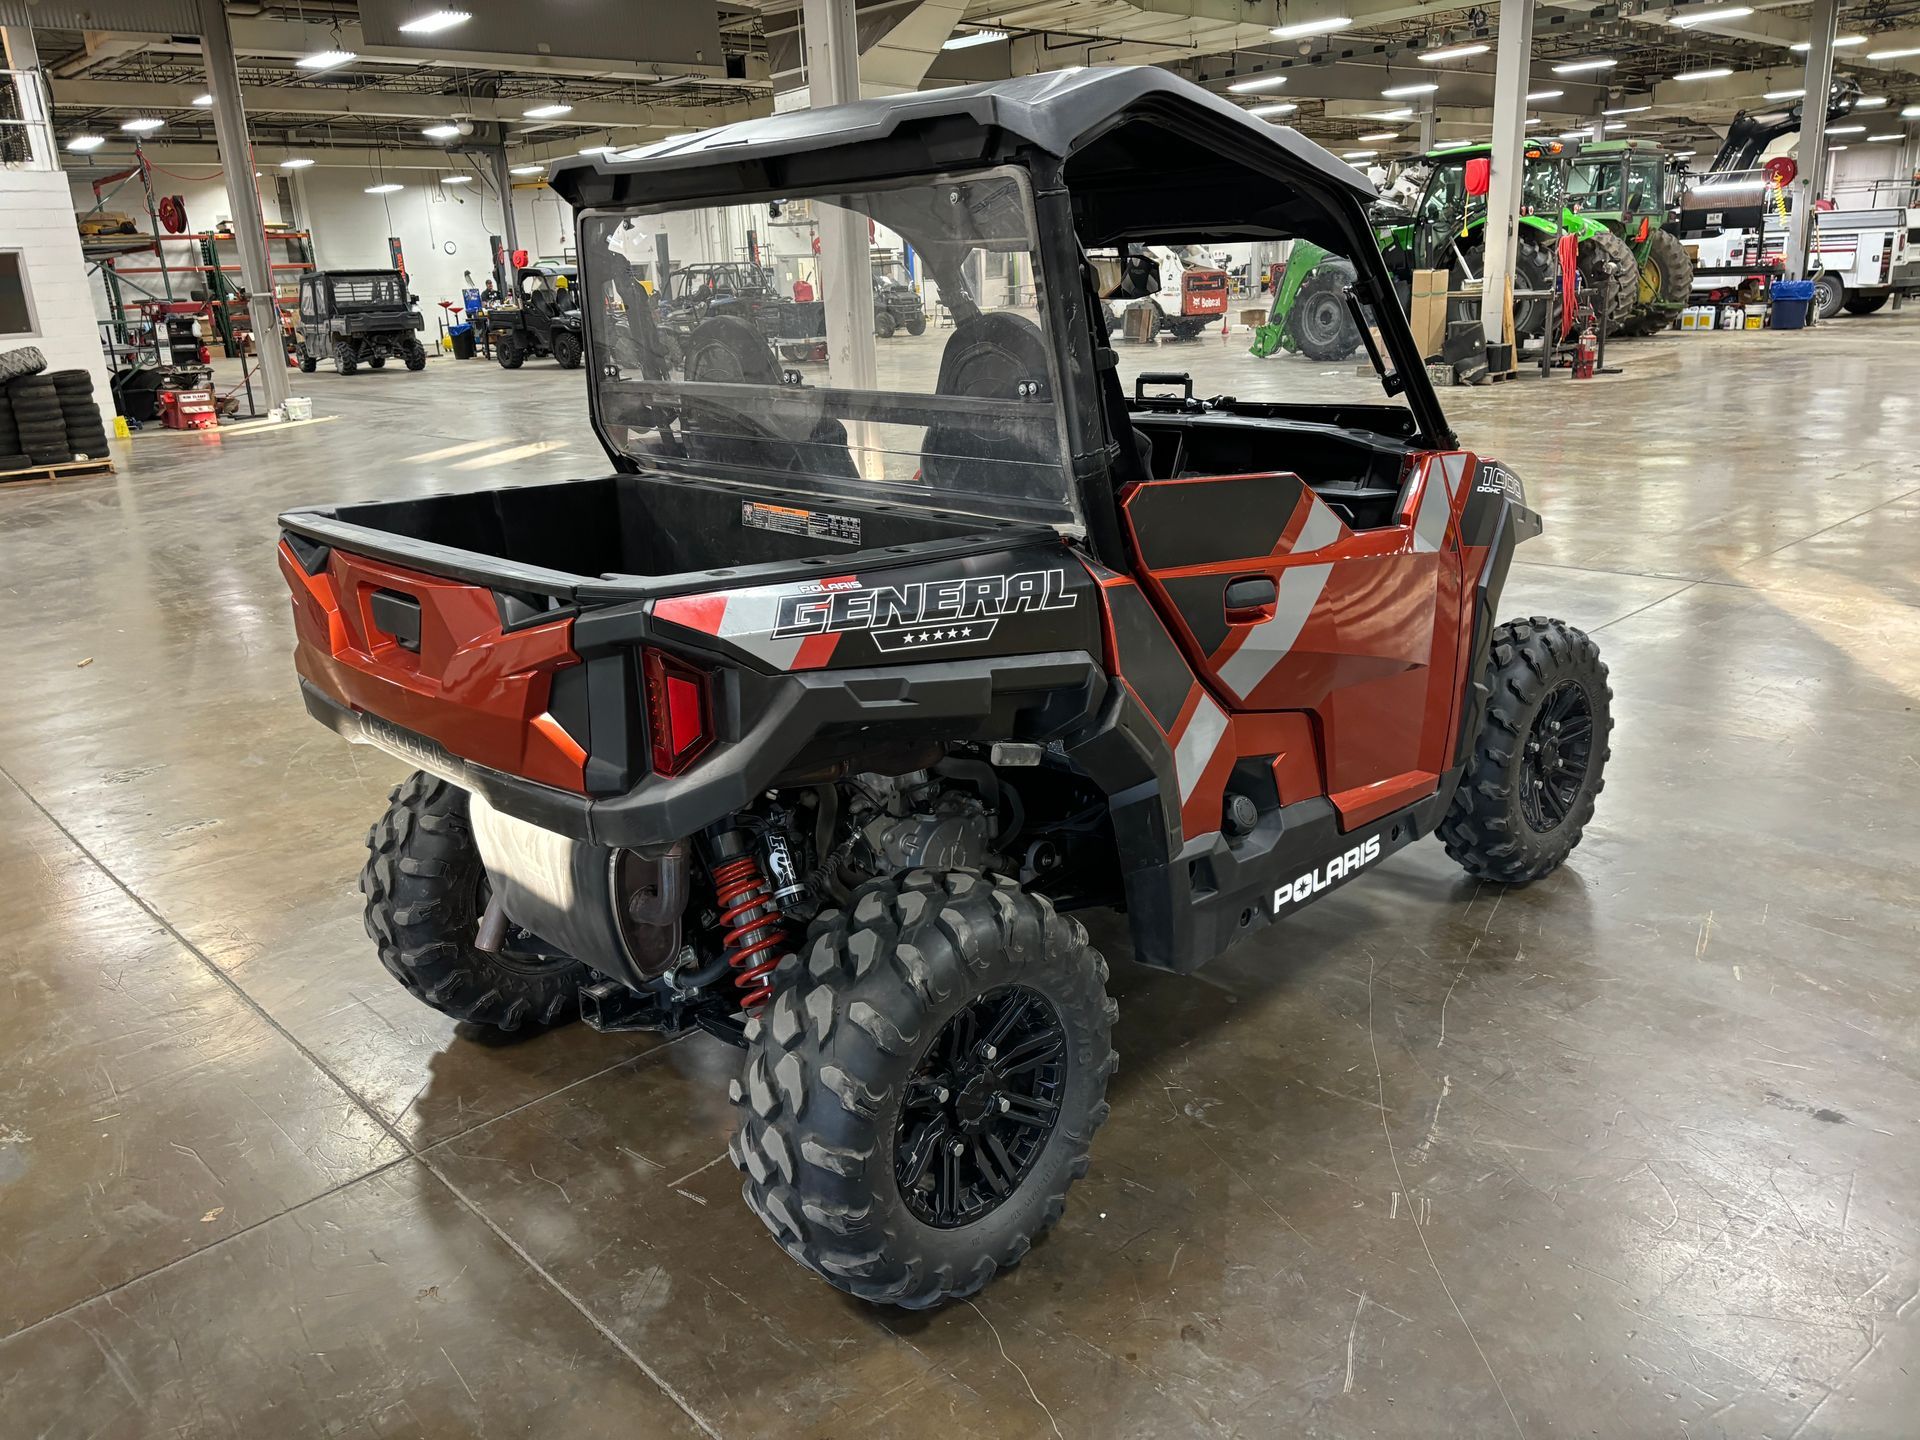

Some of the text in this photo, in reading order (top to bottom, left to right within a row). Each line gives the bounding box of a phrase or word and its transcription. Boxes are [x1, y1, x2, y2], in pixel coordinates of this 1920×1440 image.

[1201, 296, 1221, 308] Bobcat
[1476, 486, 1501, 494] DOHC
[799, 579, 863, 594] POLARIS
[771, 568, 1078, 640] GENERAL
[769, 835, 796, 882] FOX
[1273, 833, 1380, 914] POLARIS
